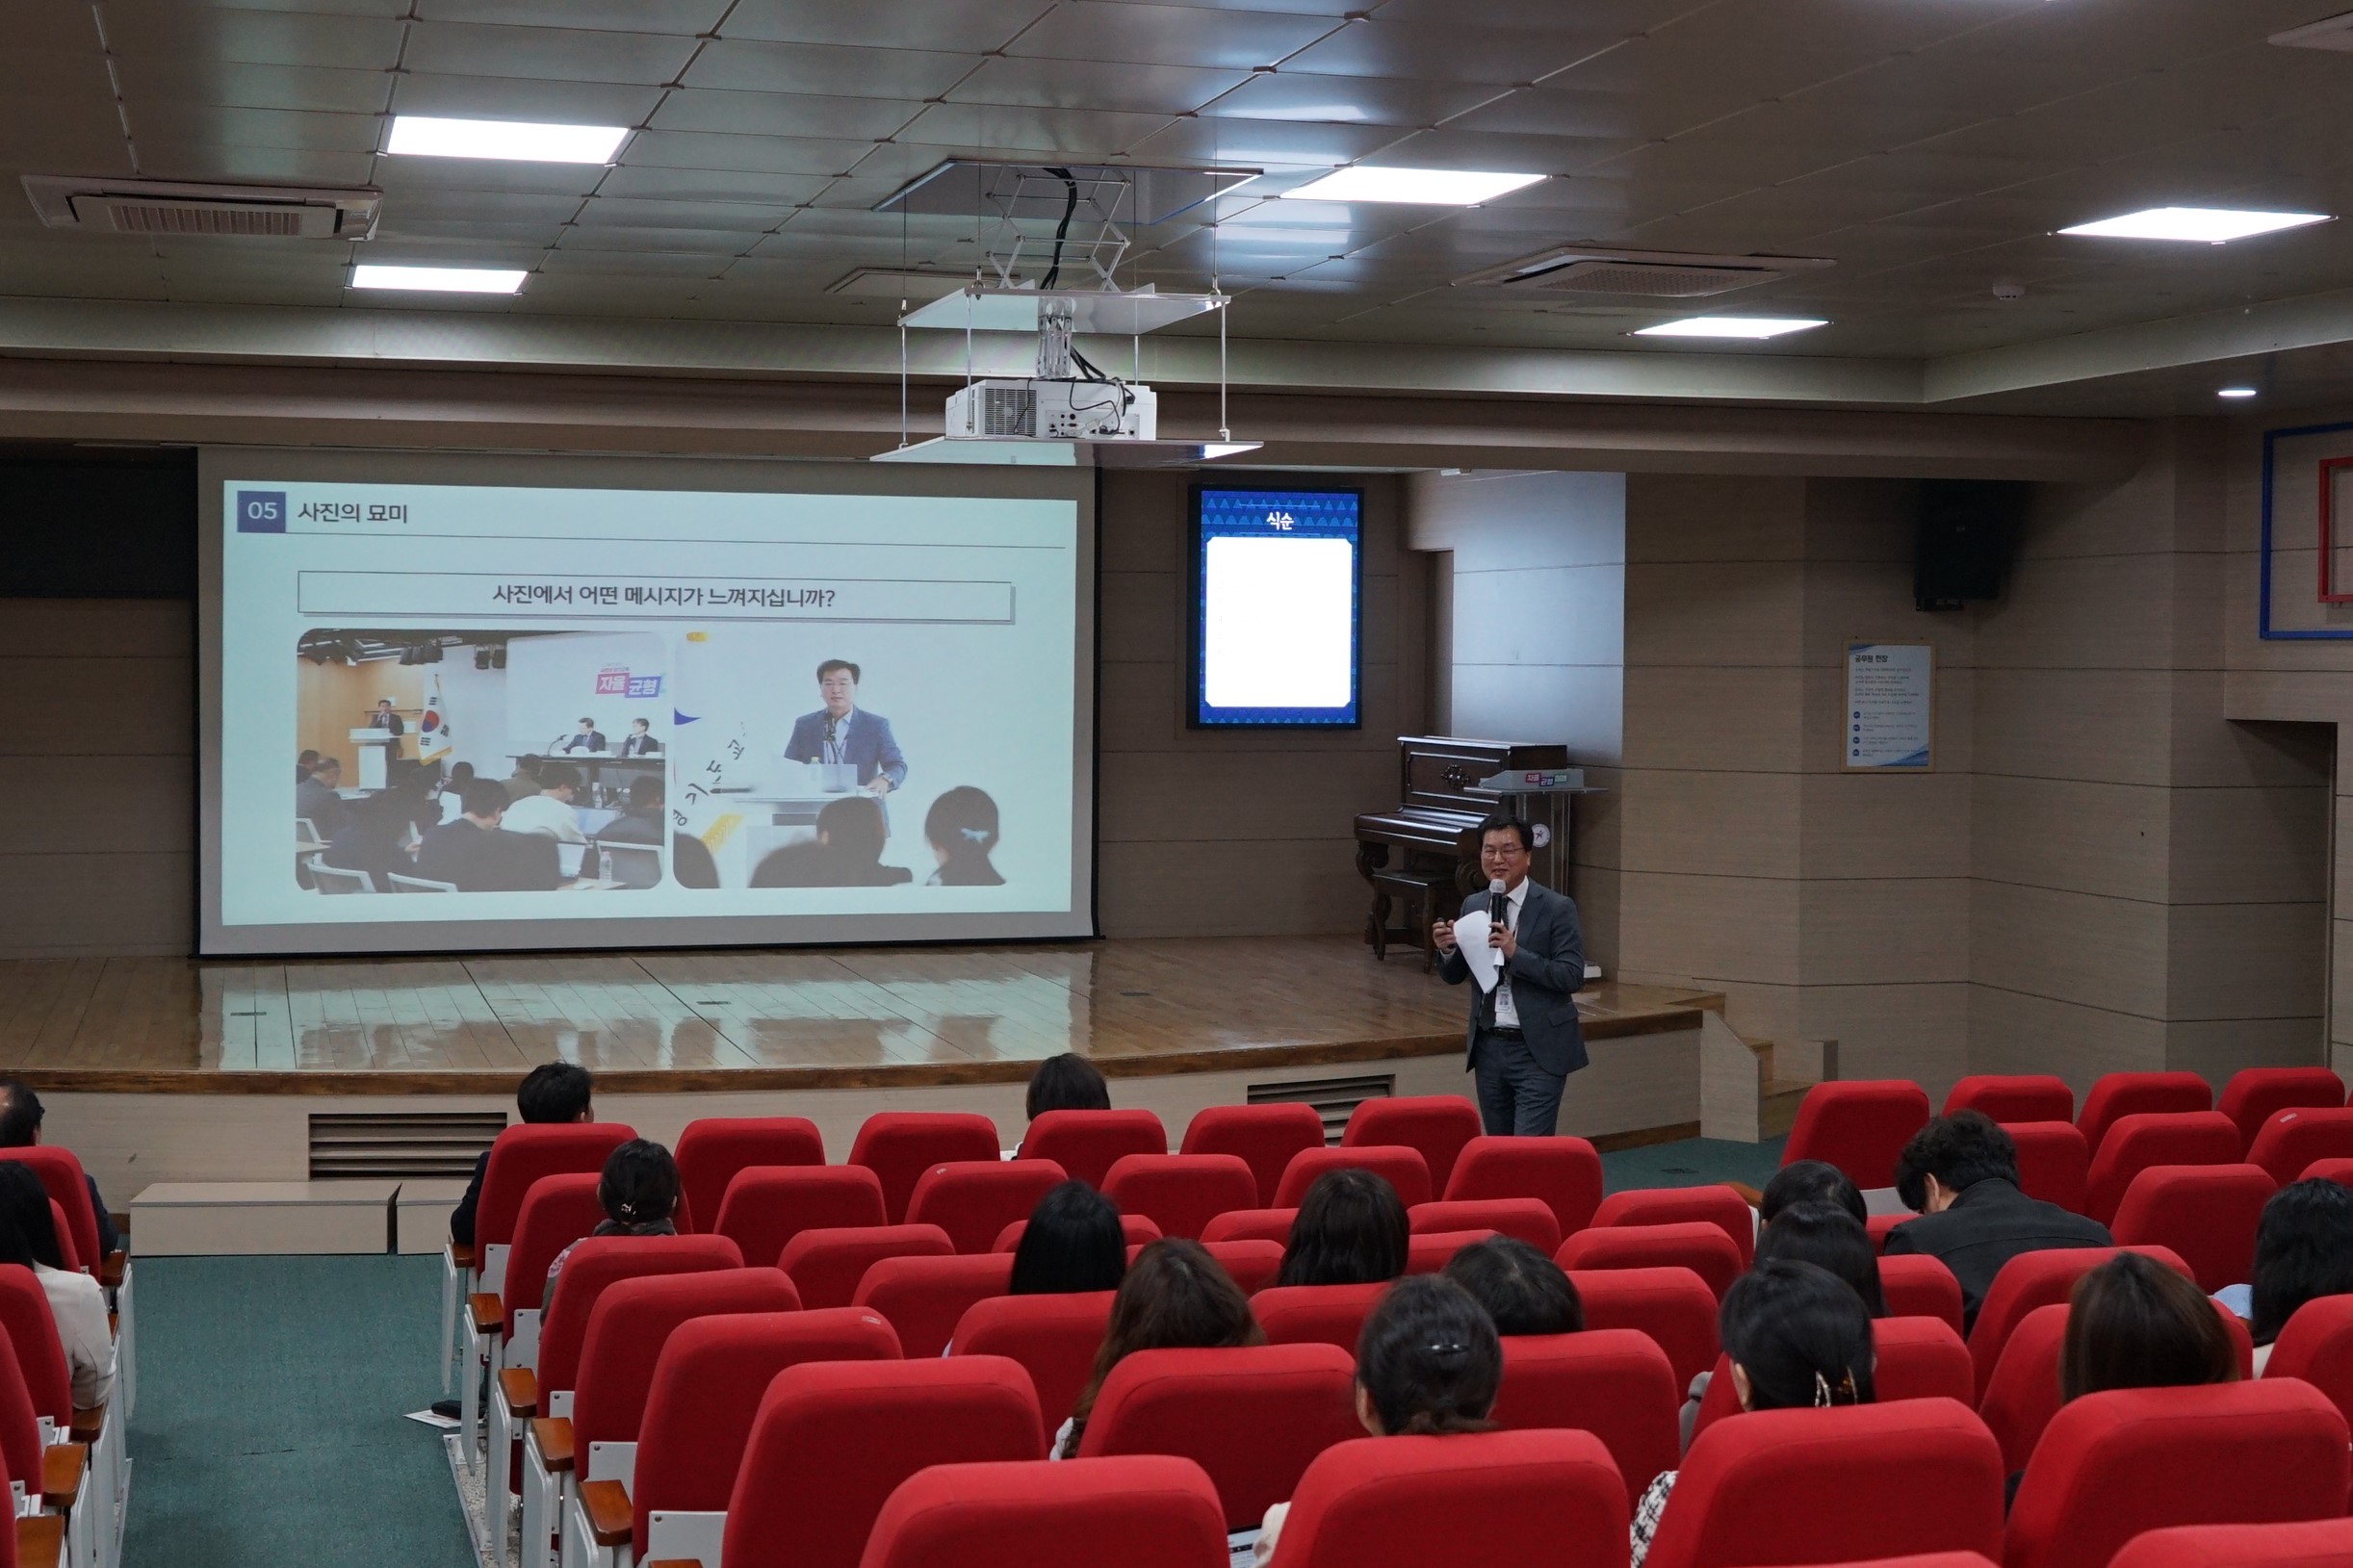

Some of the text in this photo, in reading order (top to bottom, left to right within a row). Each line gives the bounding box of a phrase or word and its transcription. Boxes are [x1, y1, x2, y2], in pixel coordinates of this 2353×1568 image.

[247, 501, 277, 520] 05
[297, 502, 407, 524] 사진의 묘미
[1266, 511, 1294, 530] 식순
[493, 585, 836, 607] 사진에서 어떤 메시지가 느껴지십니까?
[600, 676, 626, 691] 자율
